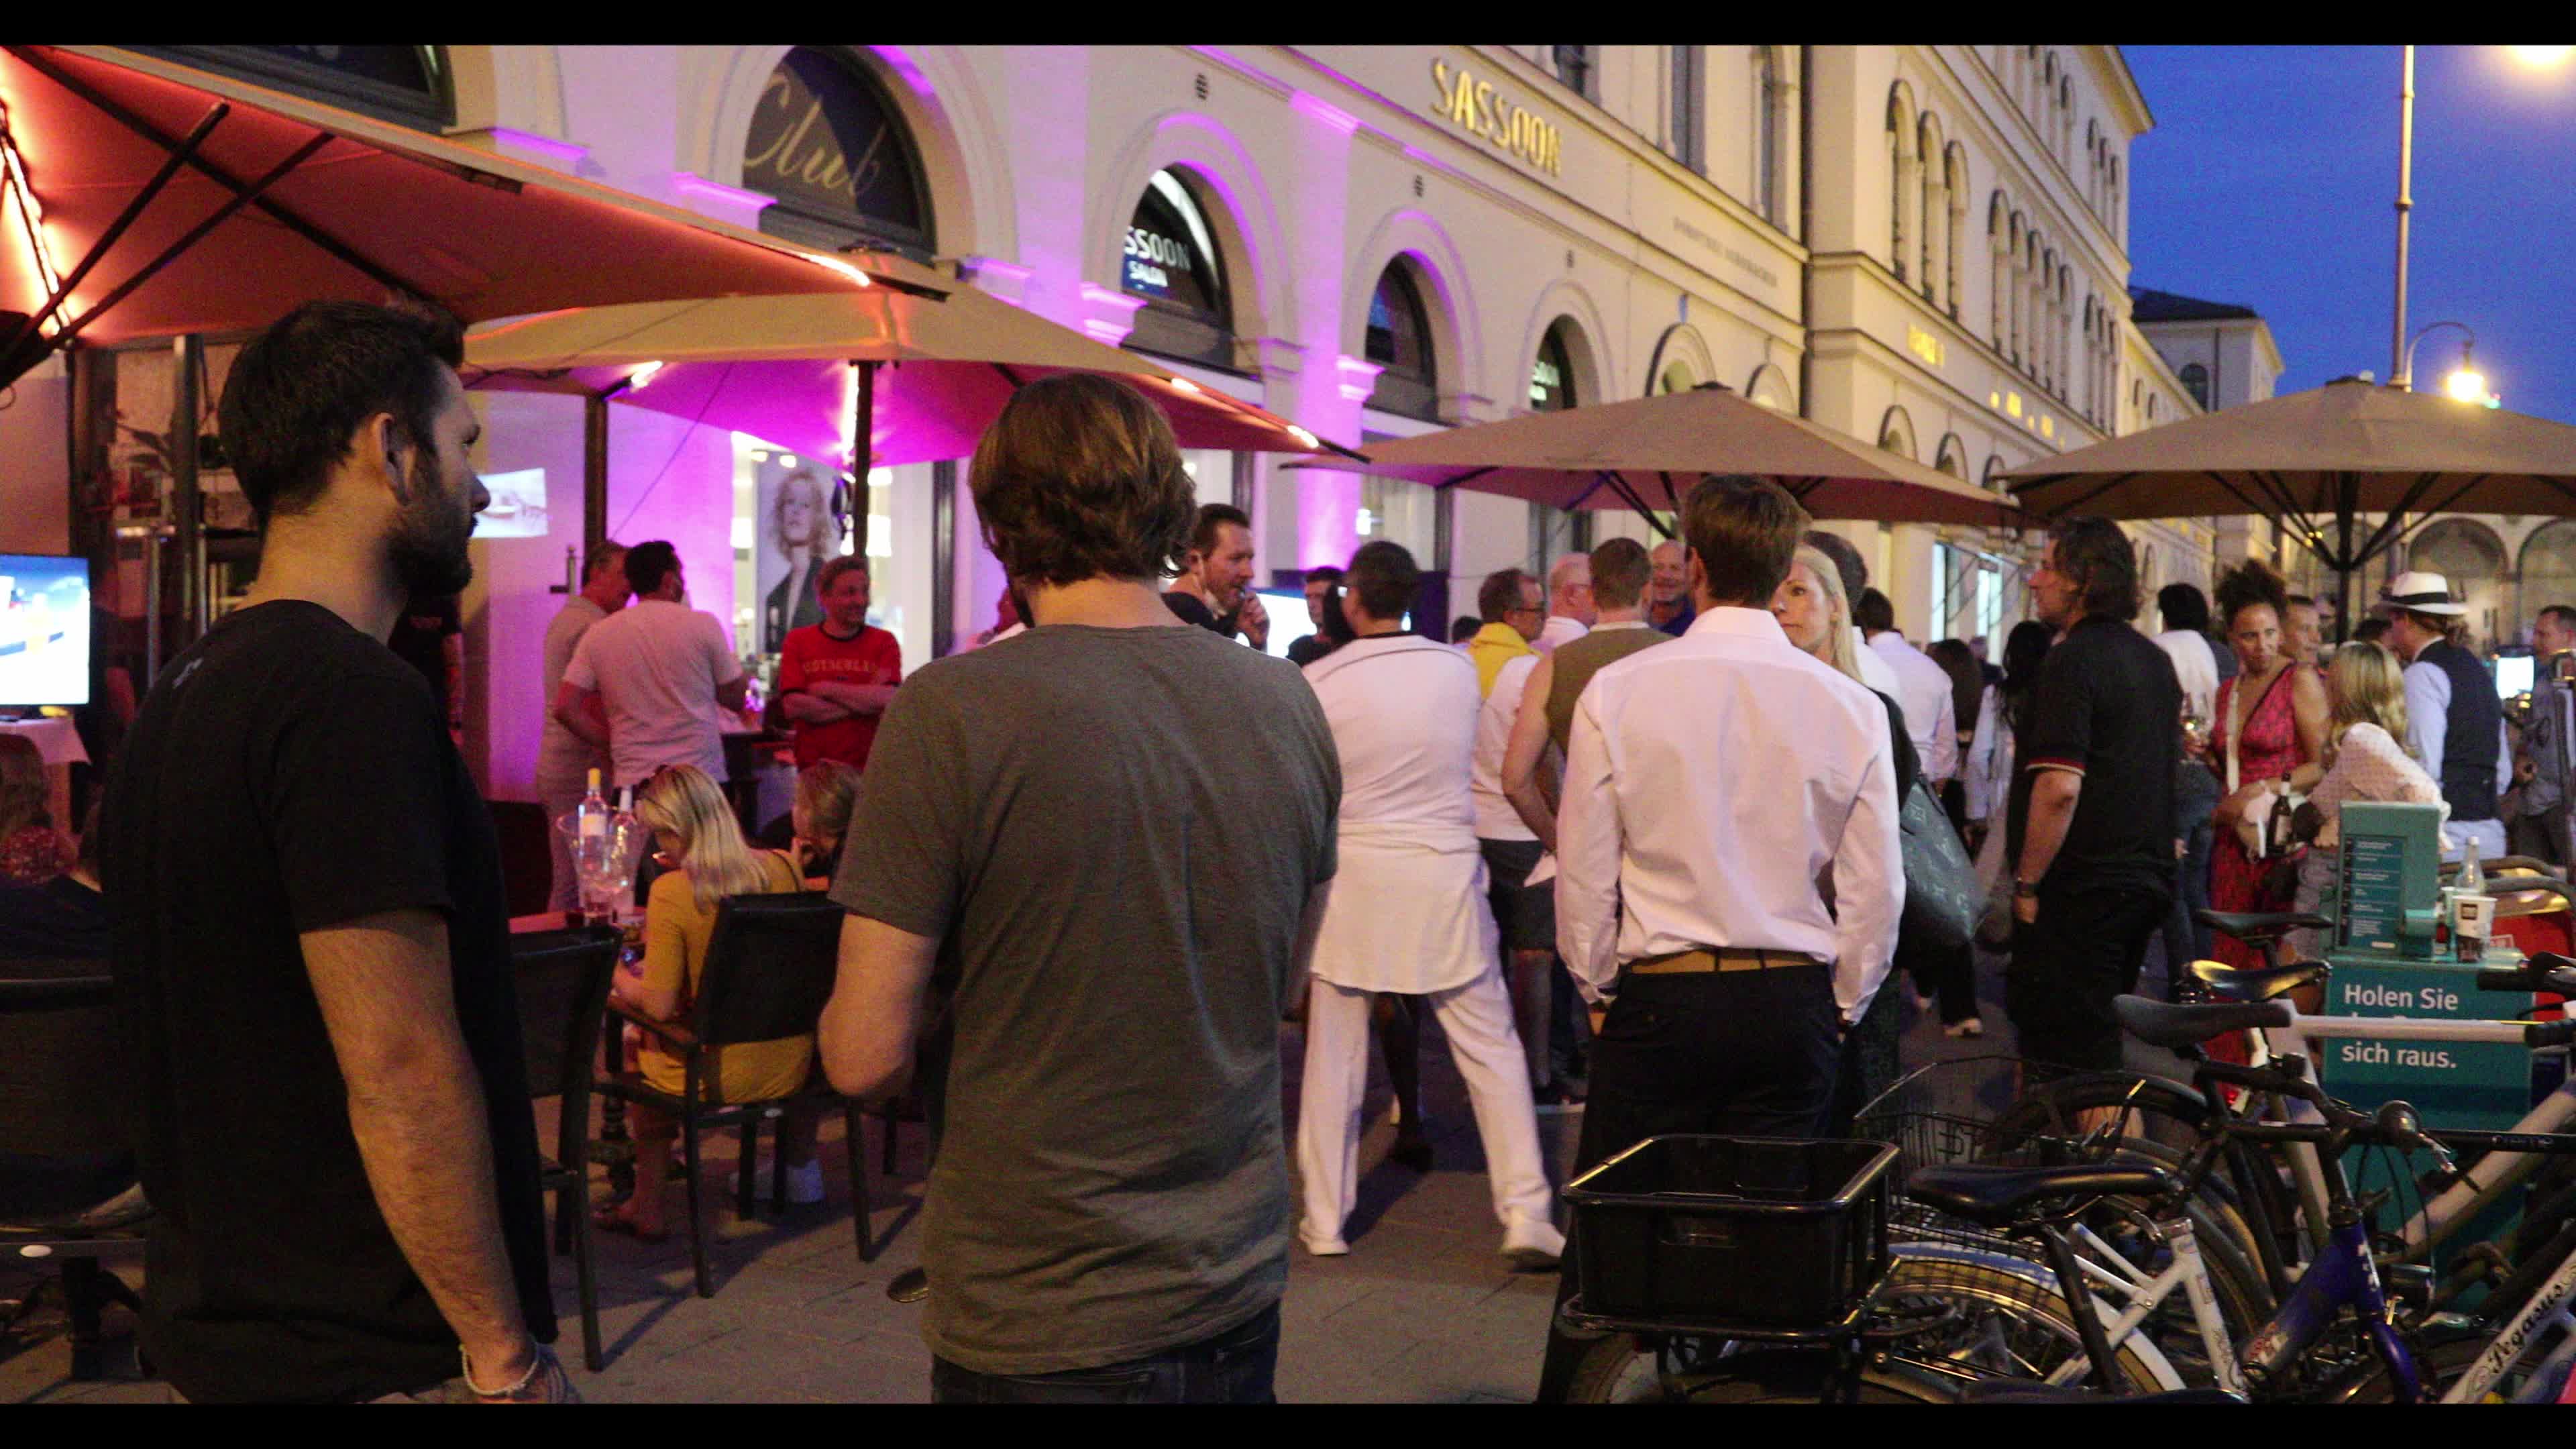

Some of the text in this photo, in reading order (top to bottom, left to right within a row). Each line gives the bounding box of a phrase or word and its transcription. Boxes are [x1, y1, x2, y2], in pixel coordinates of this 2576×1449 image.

[743, 74, 887, 202] Club
[1432, 58, 1561, 177] SASSOON
[2345, 983, 2459, 1011] Holen Sie
[2341, 1040, 2457, 1068] sich raus.
